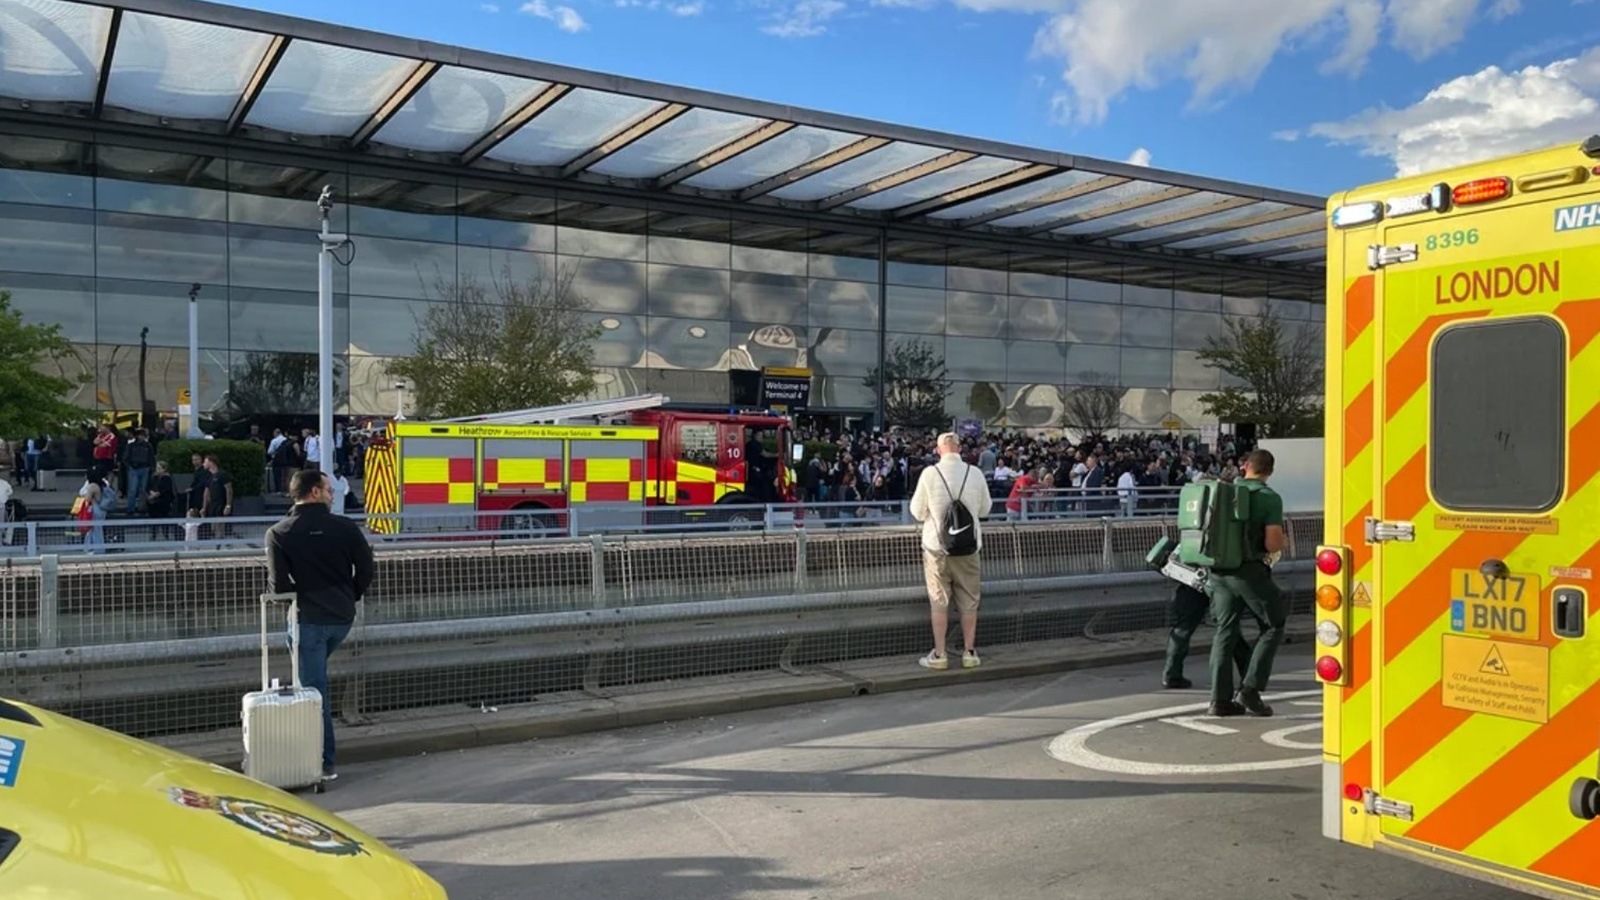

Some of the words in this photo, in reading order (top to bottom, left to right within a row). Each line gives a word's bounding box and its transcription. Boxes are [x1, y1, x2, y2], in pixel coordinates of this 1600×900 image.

[1426, 228, 1479, 250] 8396
[1436, 260, 1560, 304] LONDON
[766, 382, 799, 390] Welcome
[765, 391, 796, 399] Terminal
[459, 426, 502, 435] Heathrow
[727, 448, 740, 458] 10
[1464, 573, 1526, 602] LX17
[1472, 604, 1526, 632] BNO
